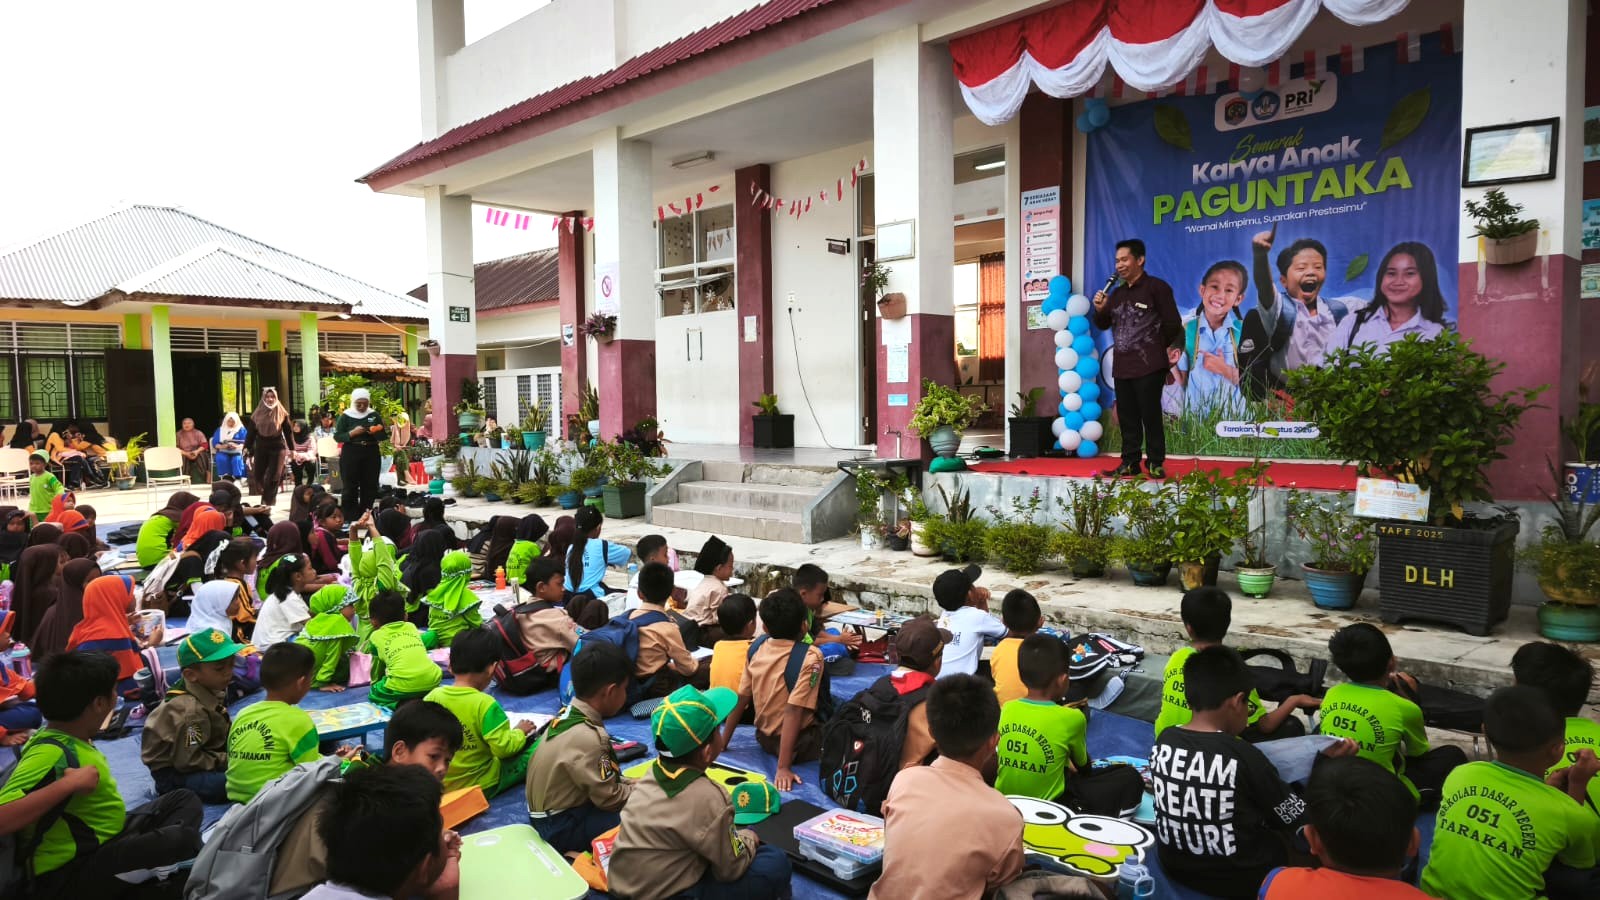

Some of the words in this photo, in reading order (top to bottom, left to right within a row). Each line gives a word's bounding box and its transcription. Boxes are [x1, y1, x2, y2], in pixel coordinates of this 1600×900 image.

[1230, 127, 1304, 163] Semarak
[1192, 154, 1275, 185] Karya
[1279, 135, 1362, 171] Anak
[1153, 157, 1412, 225] PAGUNTAKA
[1263, 210, 1307, 224] Suarakan
[1261, 425, 1293, 433] Astus
[1380, 526, 1411, 536] TAPE
[1417, 529, 1444, 539] 2025
[1405, 565, 1454, 588] DLH
[1172, 681, 1184, 693] 05
[1340, 702, 1368, 717] DASAR
[1333, 716, 1357, 732] 051
[1006, 739, 1029, 754] 051
[1013, 723, 1037, 738] DASAR
[1035, 734, 1055, 764] NEGERI
[1000, 756, 1047, 773] ARAKAN
[1152, 775, 1235, 820] REATE
[1440, 785, 1477, 817] SEKOLAH
[1480, 786, 1517, 811] DASAR
[1512, 809, 1536, 851] NEGERI
[1466, 804, 1500, 829] 051
[1156, 815, 1238, 857] UTURE
[1440, 818, 1525, 859] TARAKAN
